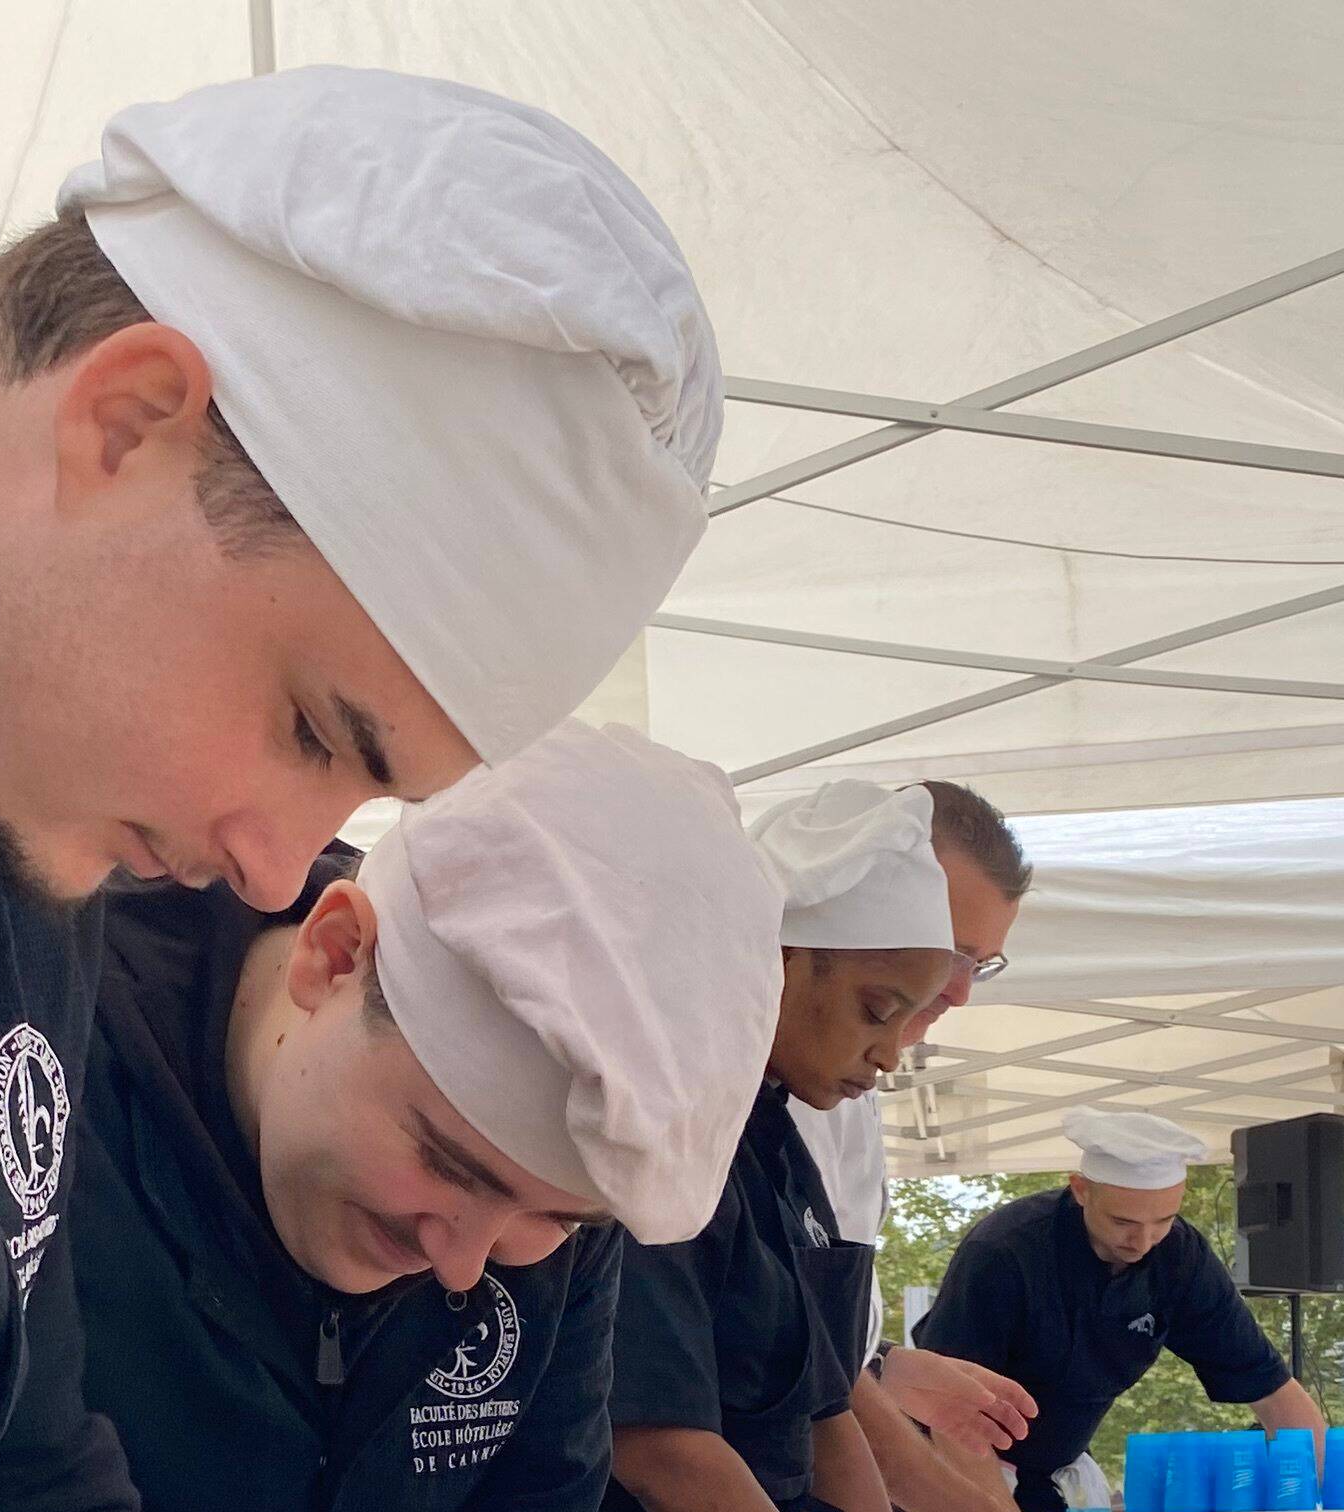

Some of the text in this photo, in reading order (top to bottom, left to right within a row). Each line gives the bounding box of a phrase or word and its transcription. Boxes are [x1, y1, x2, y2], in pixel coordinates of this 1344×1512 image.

[486, 1331, 515, 1384] EMPLOI
[451, 1380, 482, 1393] 1946
[410, 1401, 456, 1424] FACULTÉ
[457, 1403, 479, 1420] DES
[412, 1428, 452, 1450] ÉCOLE
[413, 1456, 437, 1473] DE
